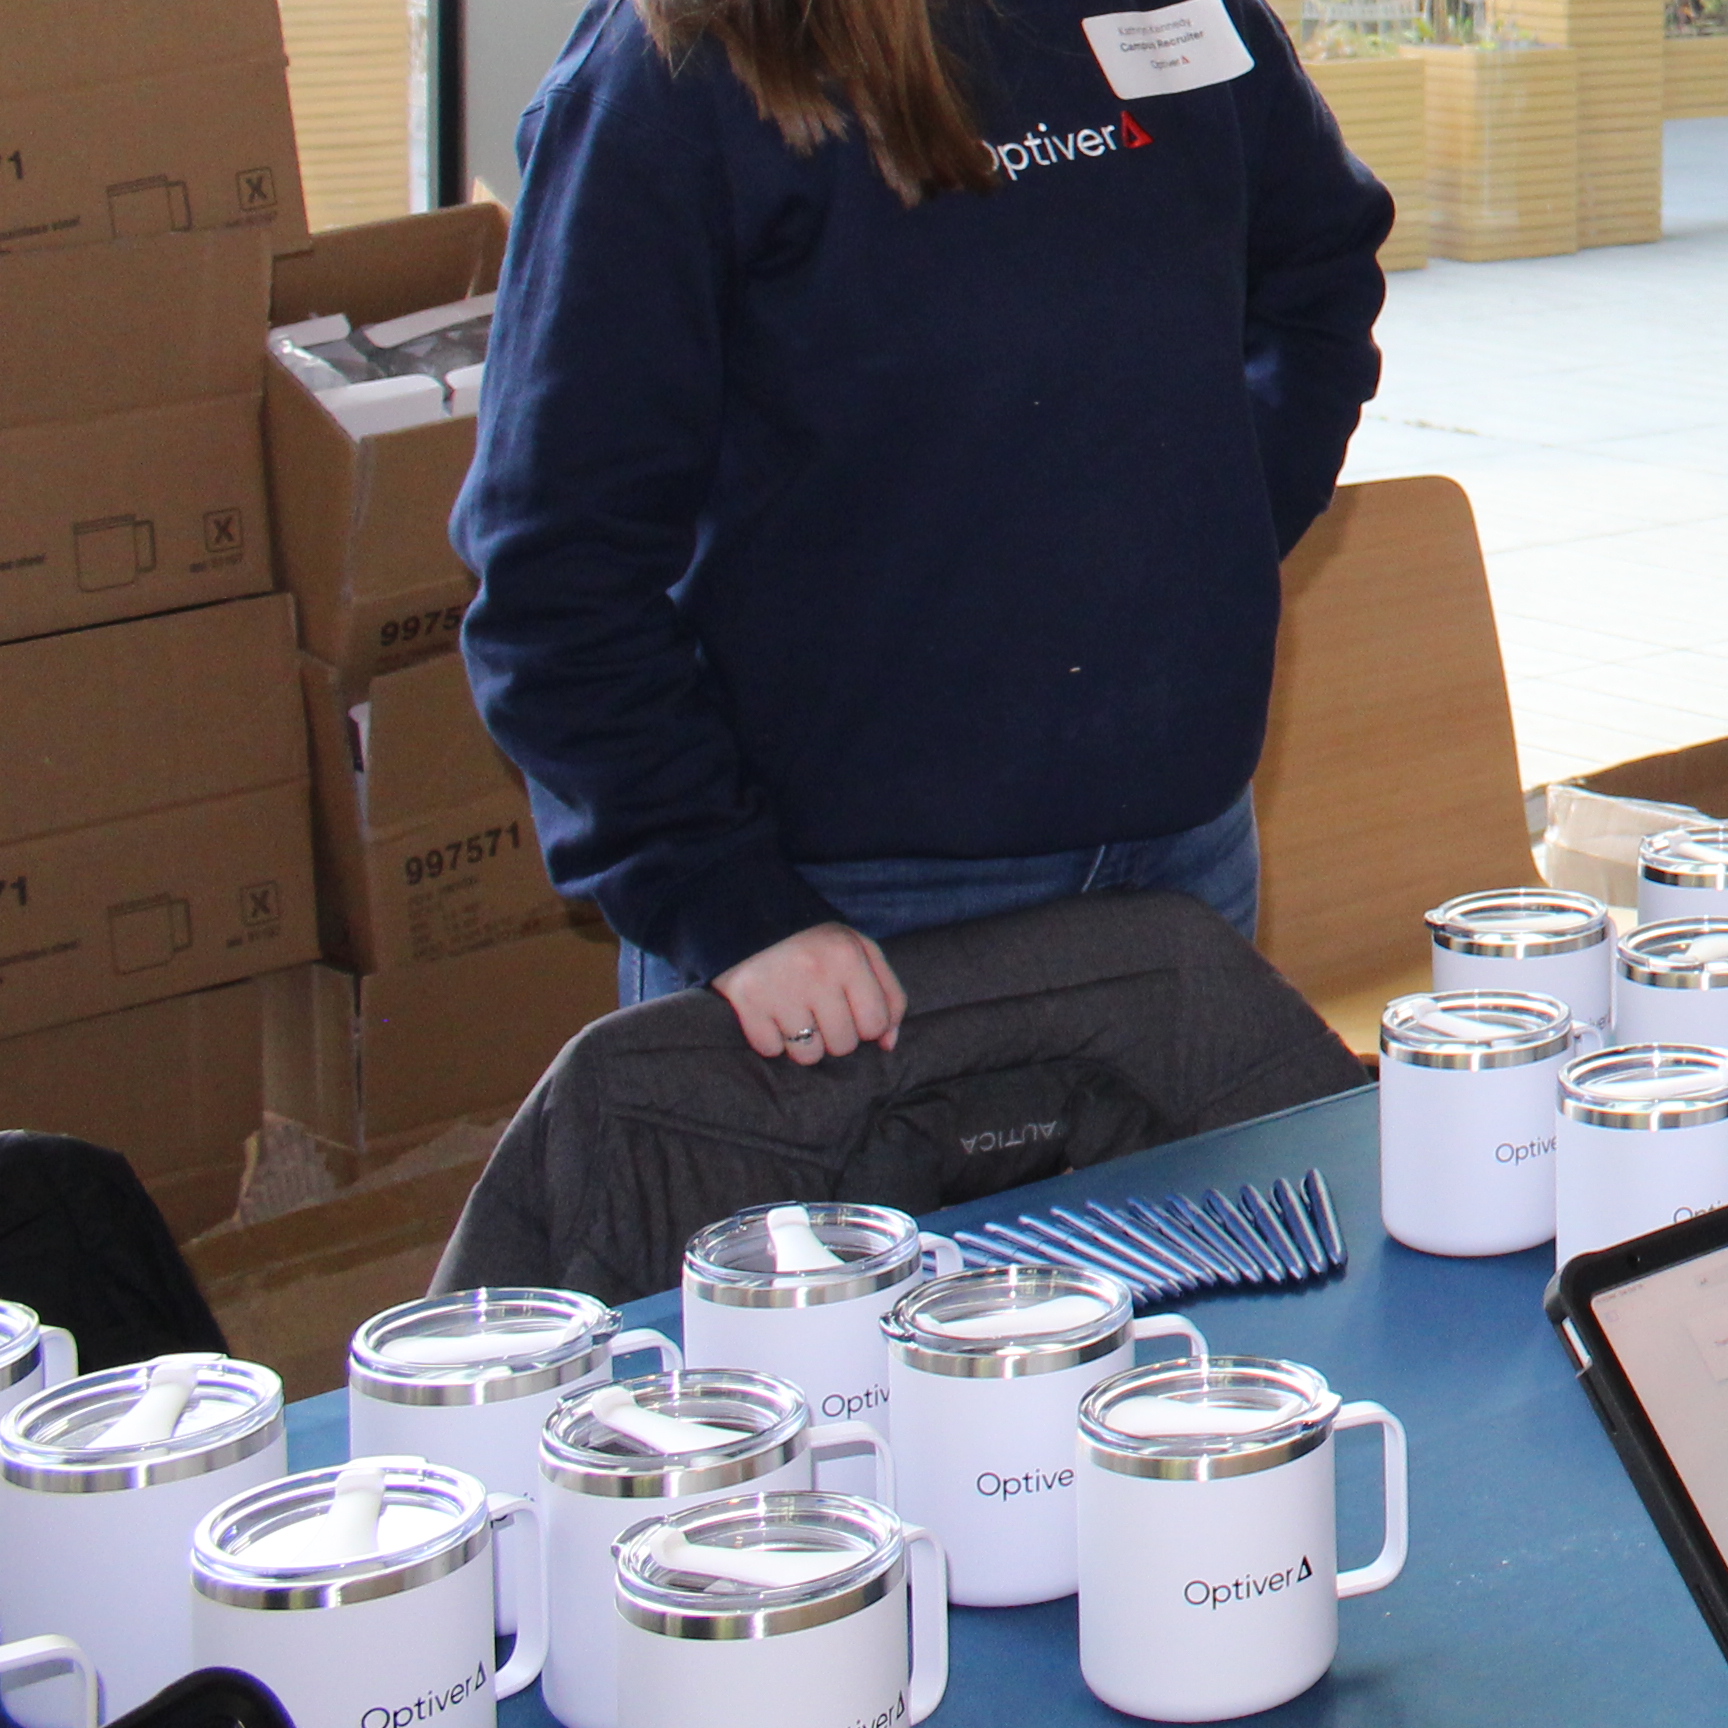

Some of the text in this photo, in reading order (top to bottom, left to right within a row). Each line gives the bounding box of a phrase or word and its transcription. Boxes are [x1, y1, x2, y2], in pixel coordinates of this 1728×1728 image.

[1157, 30, 1205, 49] Recruiter
[380, 604, 470, 648] 9975
[404, 818, 523, 886] 997571
[959, 1120, 1059, 1154] AUTICA
[1495, 1135, 1557, 1166] Optive
[822, 1383, 890, 1420] Optiv
[976, 1468, 1075, 1502] Optive
[1184, 1567, 1294, 1610] Optiver
[361, 1676, 473, 1728] Optiver
